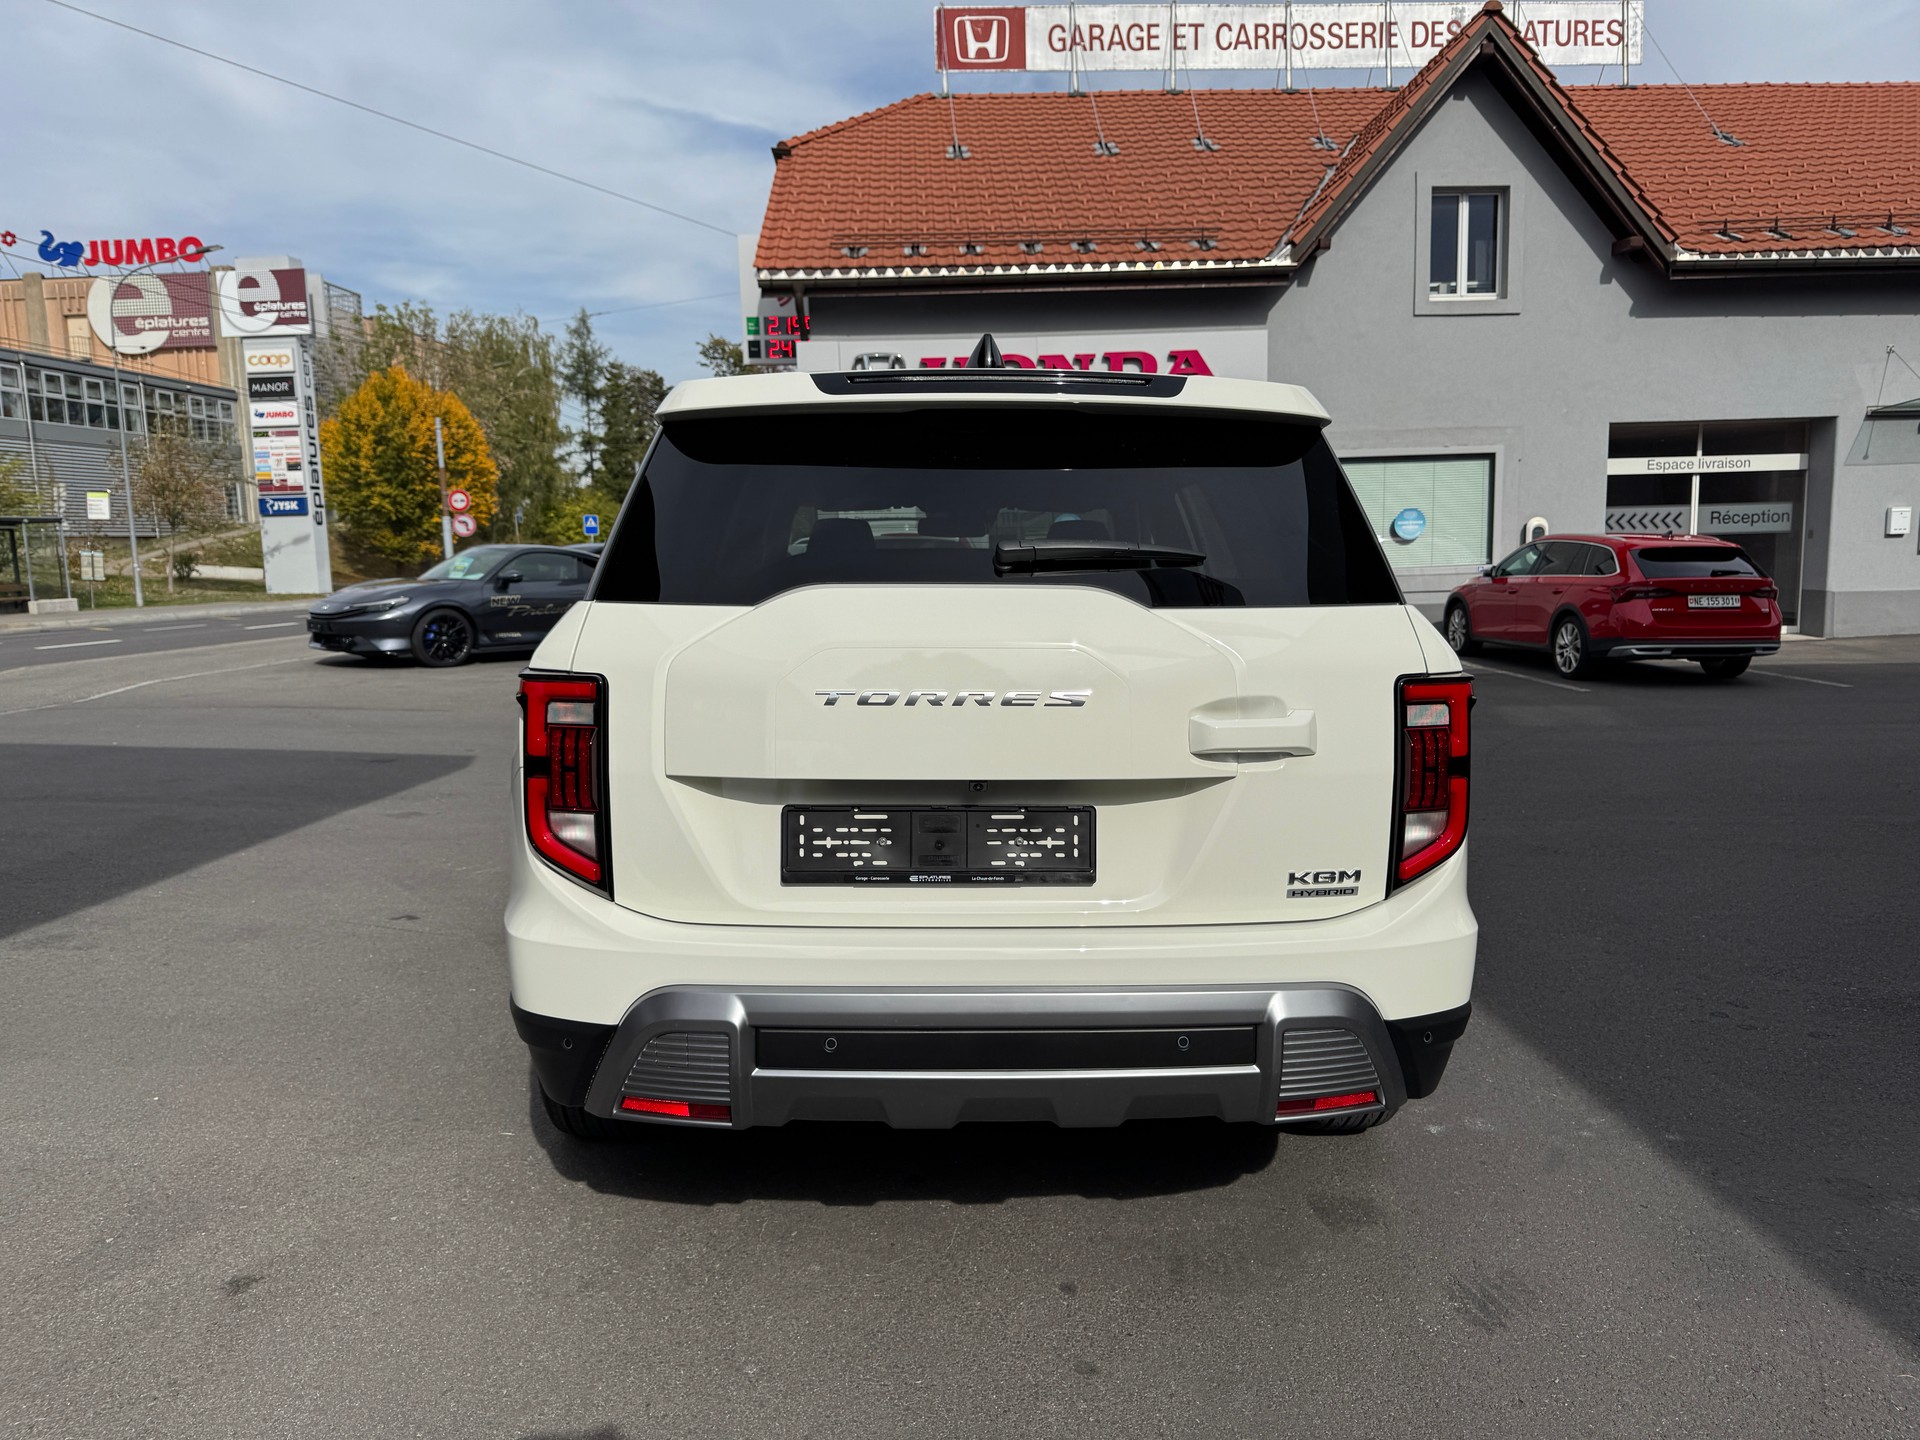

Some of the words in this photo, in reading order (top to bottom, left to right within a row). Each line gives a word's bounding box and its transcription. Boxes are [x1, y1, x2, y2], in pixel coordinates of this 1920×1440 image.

[1048, 23, 1160, 52] GARAGE
[1173, 22, 1205, 51] ET
[1215, 21, 1399, 51] CARROSSERIE
[1522, 19, 1624, 48] ATURES
[84, 236, 205, 267] JUMBO
[253, 300, 307, 313] éplatures
[279, 309, 307, 319] centre
[134, 315, 210, 330] éplatures
[171, 327, 211, 338] centre
[247, 354, 291, 369] coop
[251, 381, 290, 393] MANOR
[265, 410, 295, 419] JUMBO
[1646, 459, 1695, 473] Espace
[1697, 457, 1752, 470] livraison
[272, 500, 300, 511] JYSK
[1709, 508, 1791, 527] Réception
[490, 594, 521, 608] NEW
[1693, 597, 1704, 606] NE
[507, 602, 574, 618] Prelud
[814, 689, 1093, 707] TORRES
[1286, 868, 1362, 886] KGM
[1291, 887, 1355, 898] HYBRID
